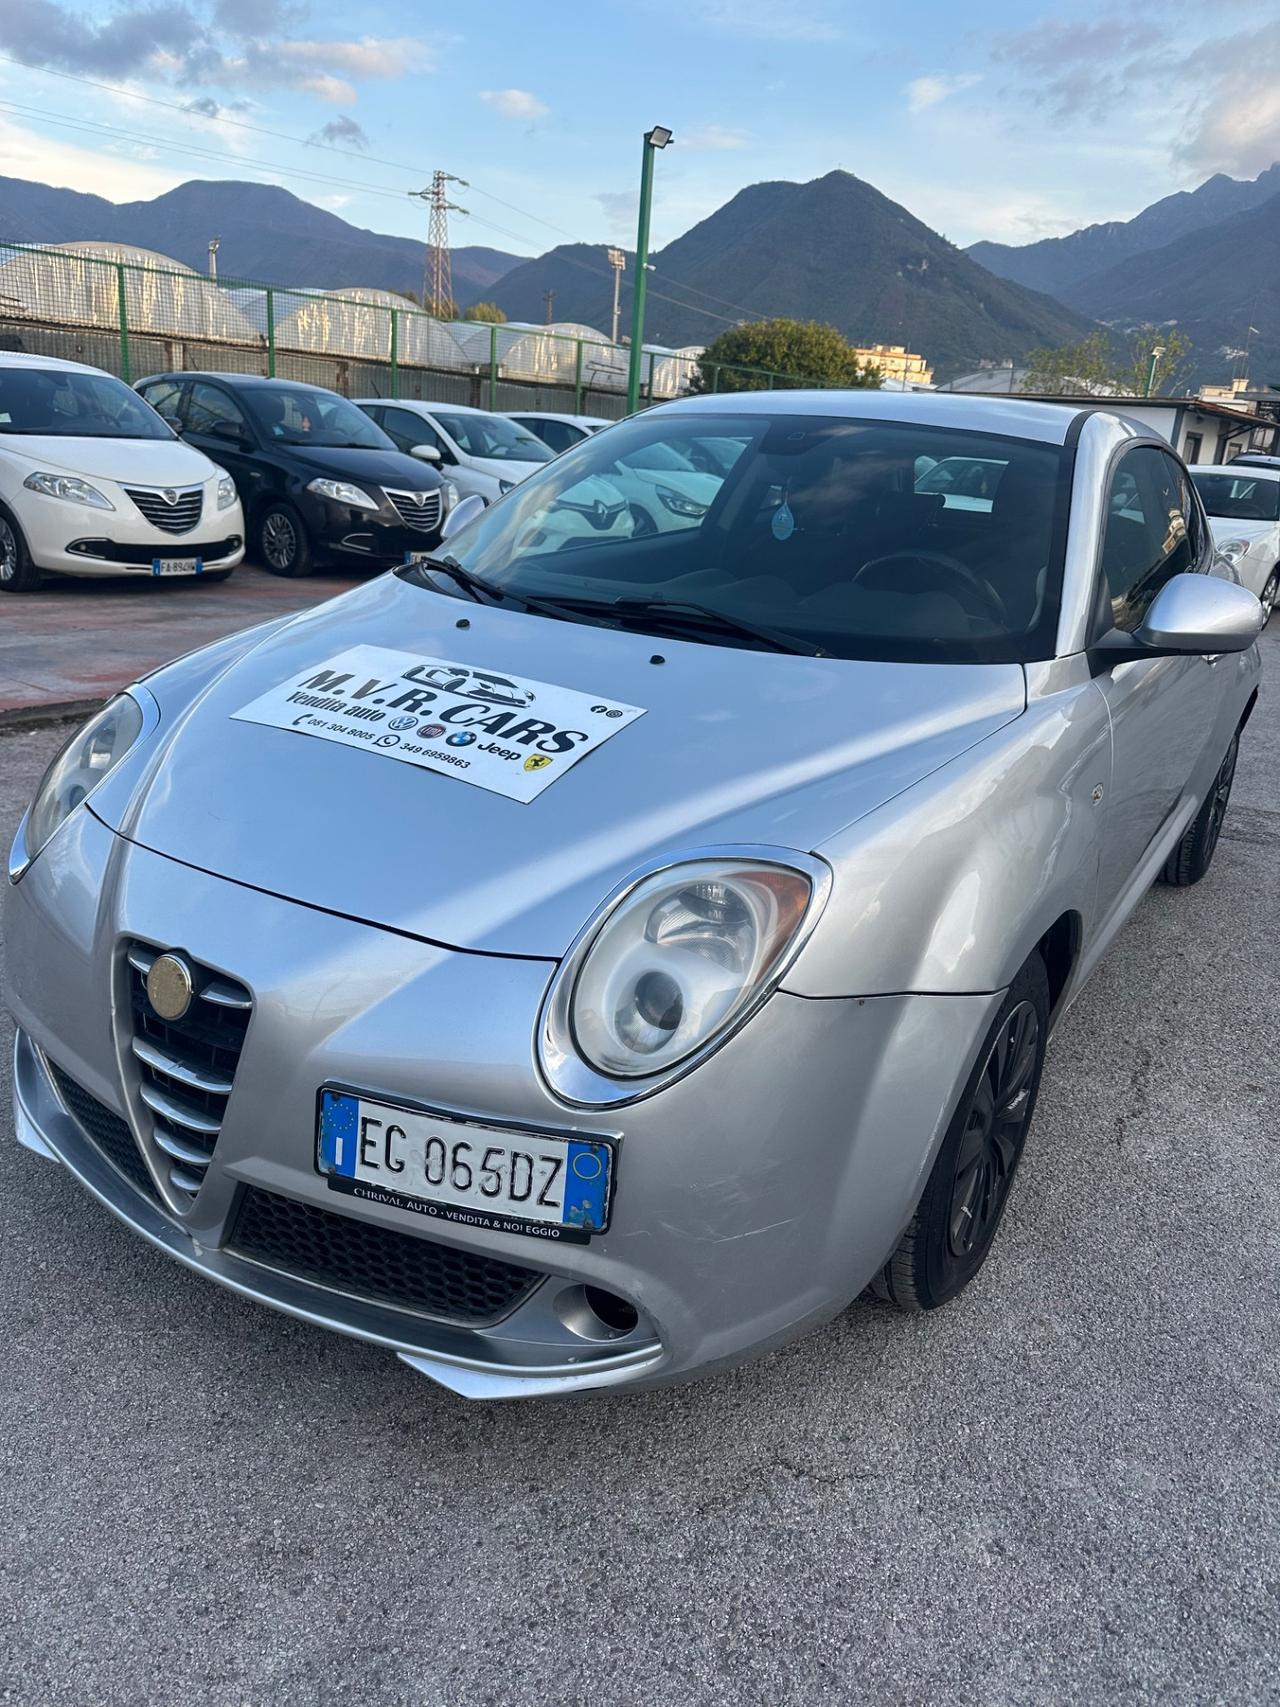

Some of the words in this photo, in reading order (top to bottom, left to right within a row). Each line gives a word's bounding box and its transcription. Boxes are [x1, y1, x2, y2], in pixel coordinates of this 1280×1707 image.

[285, 691, 347, 713] Vendita
[343, 704, 386, 722] auto
[307, 717, 327, 728] 081
[327, 723, 349, 734] 304
[346, 728, 376, 741] 8005
[400, 742, 423, 754] 349
[421, 749, 471, 769] 6959863
[477, 742, 522, 761] Jeep
[424, 1136, 564, 1207] 065DZ
[353, 1187, 403, 1207] CHRIVAL
[406, 1200, 438, 1216] AUTO
[446, 1210, 491, 1227] VENDITA
[492, 1219, 501, 1228] &
